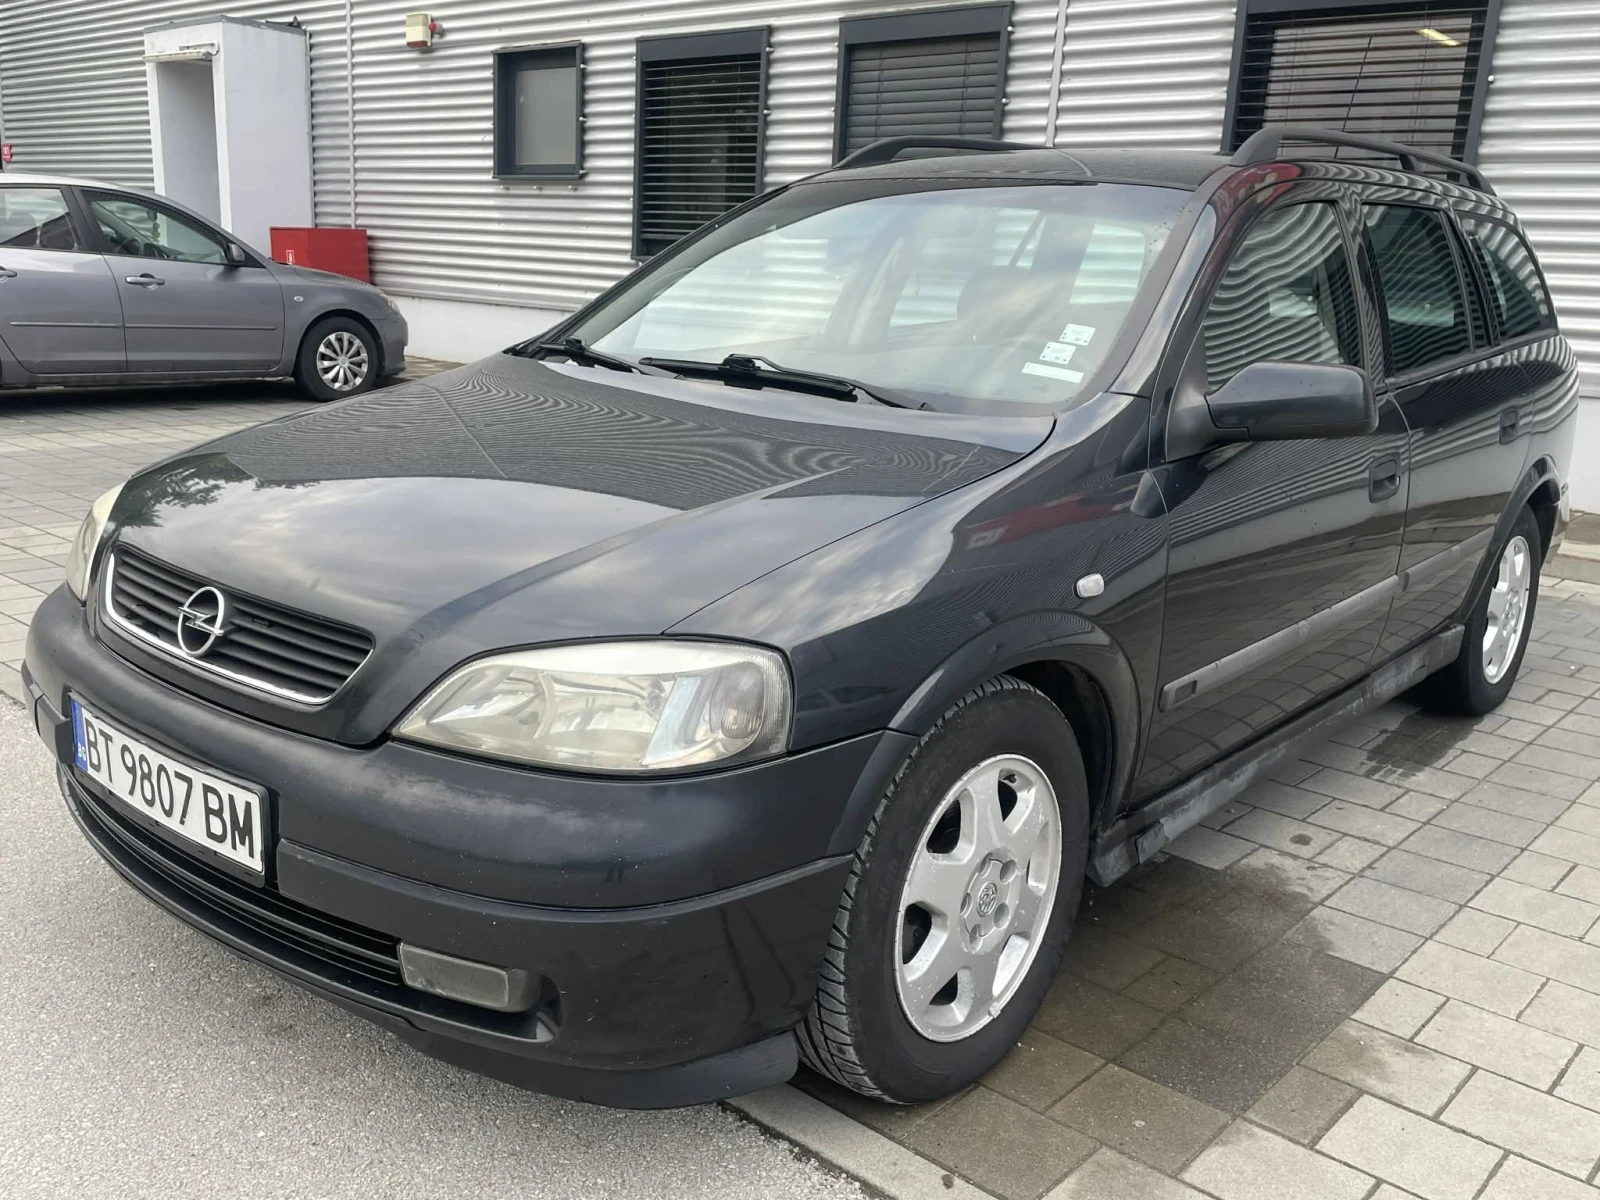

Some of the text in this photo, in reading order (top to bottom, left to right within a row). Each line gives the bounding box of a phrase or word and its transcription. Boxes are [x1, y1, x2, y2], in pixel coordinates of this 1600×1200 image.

[84, 719, 255, 859] BT 9807 BM
